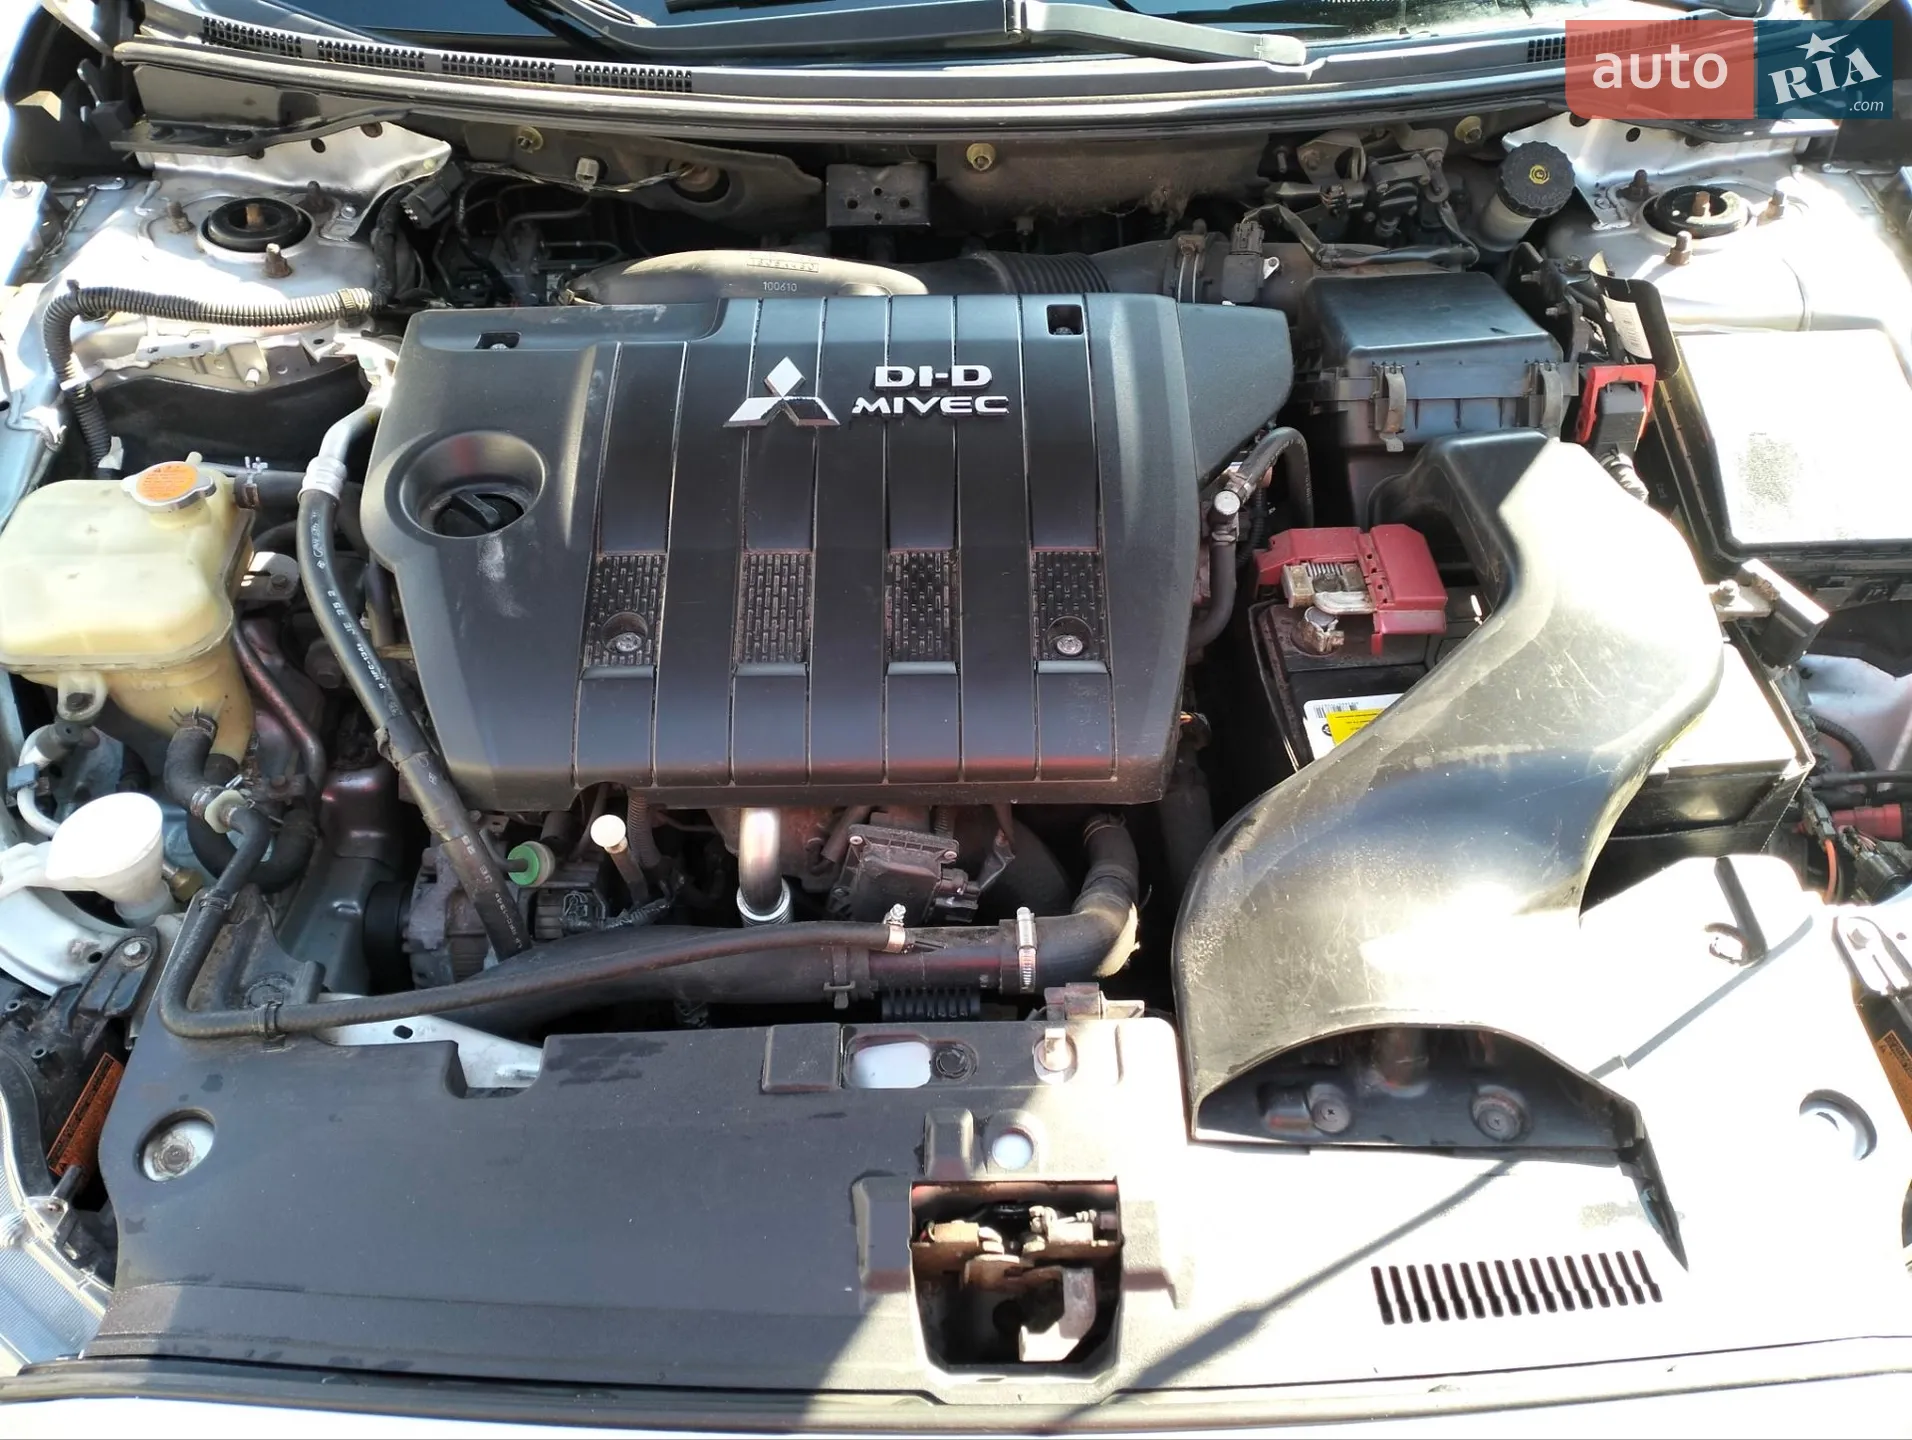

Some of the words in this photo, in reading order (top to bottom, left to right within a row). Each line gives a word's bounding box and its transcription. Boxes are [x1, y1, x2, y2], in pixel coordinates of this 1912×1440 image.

[762, 281, 798, 292] 100610
[874, 365, 993, 388] DI-D
[851, 396, 1010, 415] MIVEC
